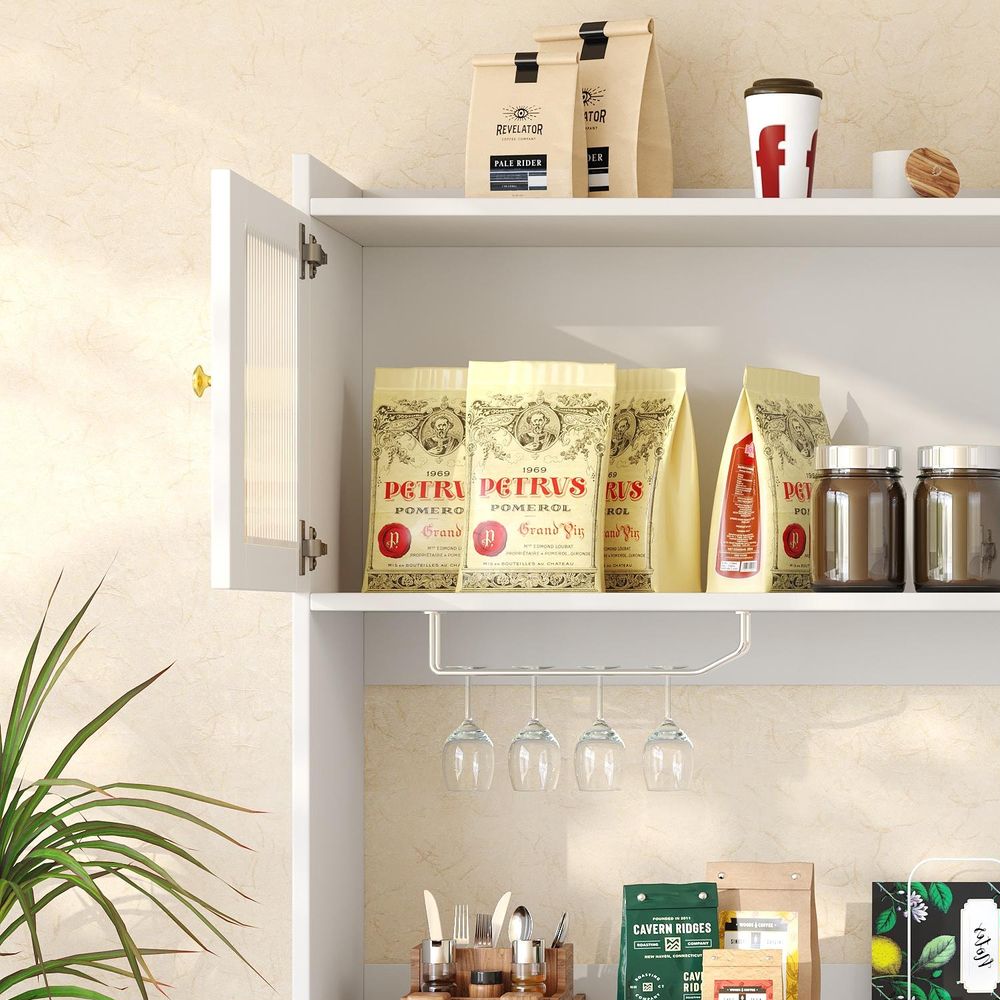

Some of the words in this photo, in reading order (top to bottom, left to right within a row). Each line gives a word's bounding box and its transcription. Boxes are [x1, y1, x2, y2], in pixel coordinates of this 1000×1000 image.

[496, 124, 544, 136] REVELATOR
[490, 504, 571, 512] POMEROL
[517, 521, 559, 537] Grand
[633, 924, 673, 935] CAVERN
[676, 923, 712, 934] RIDGES
[635, 973, 660, 981] ROASTING
